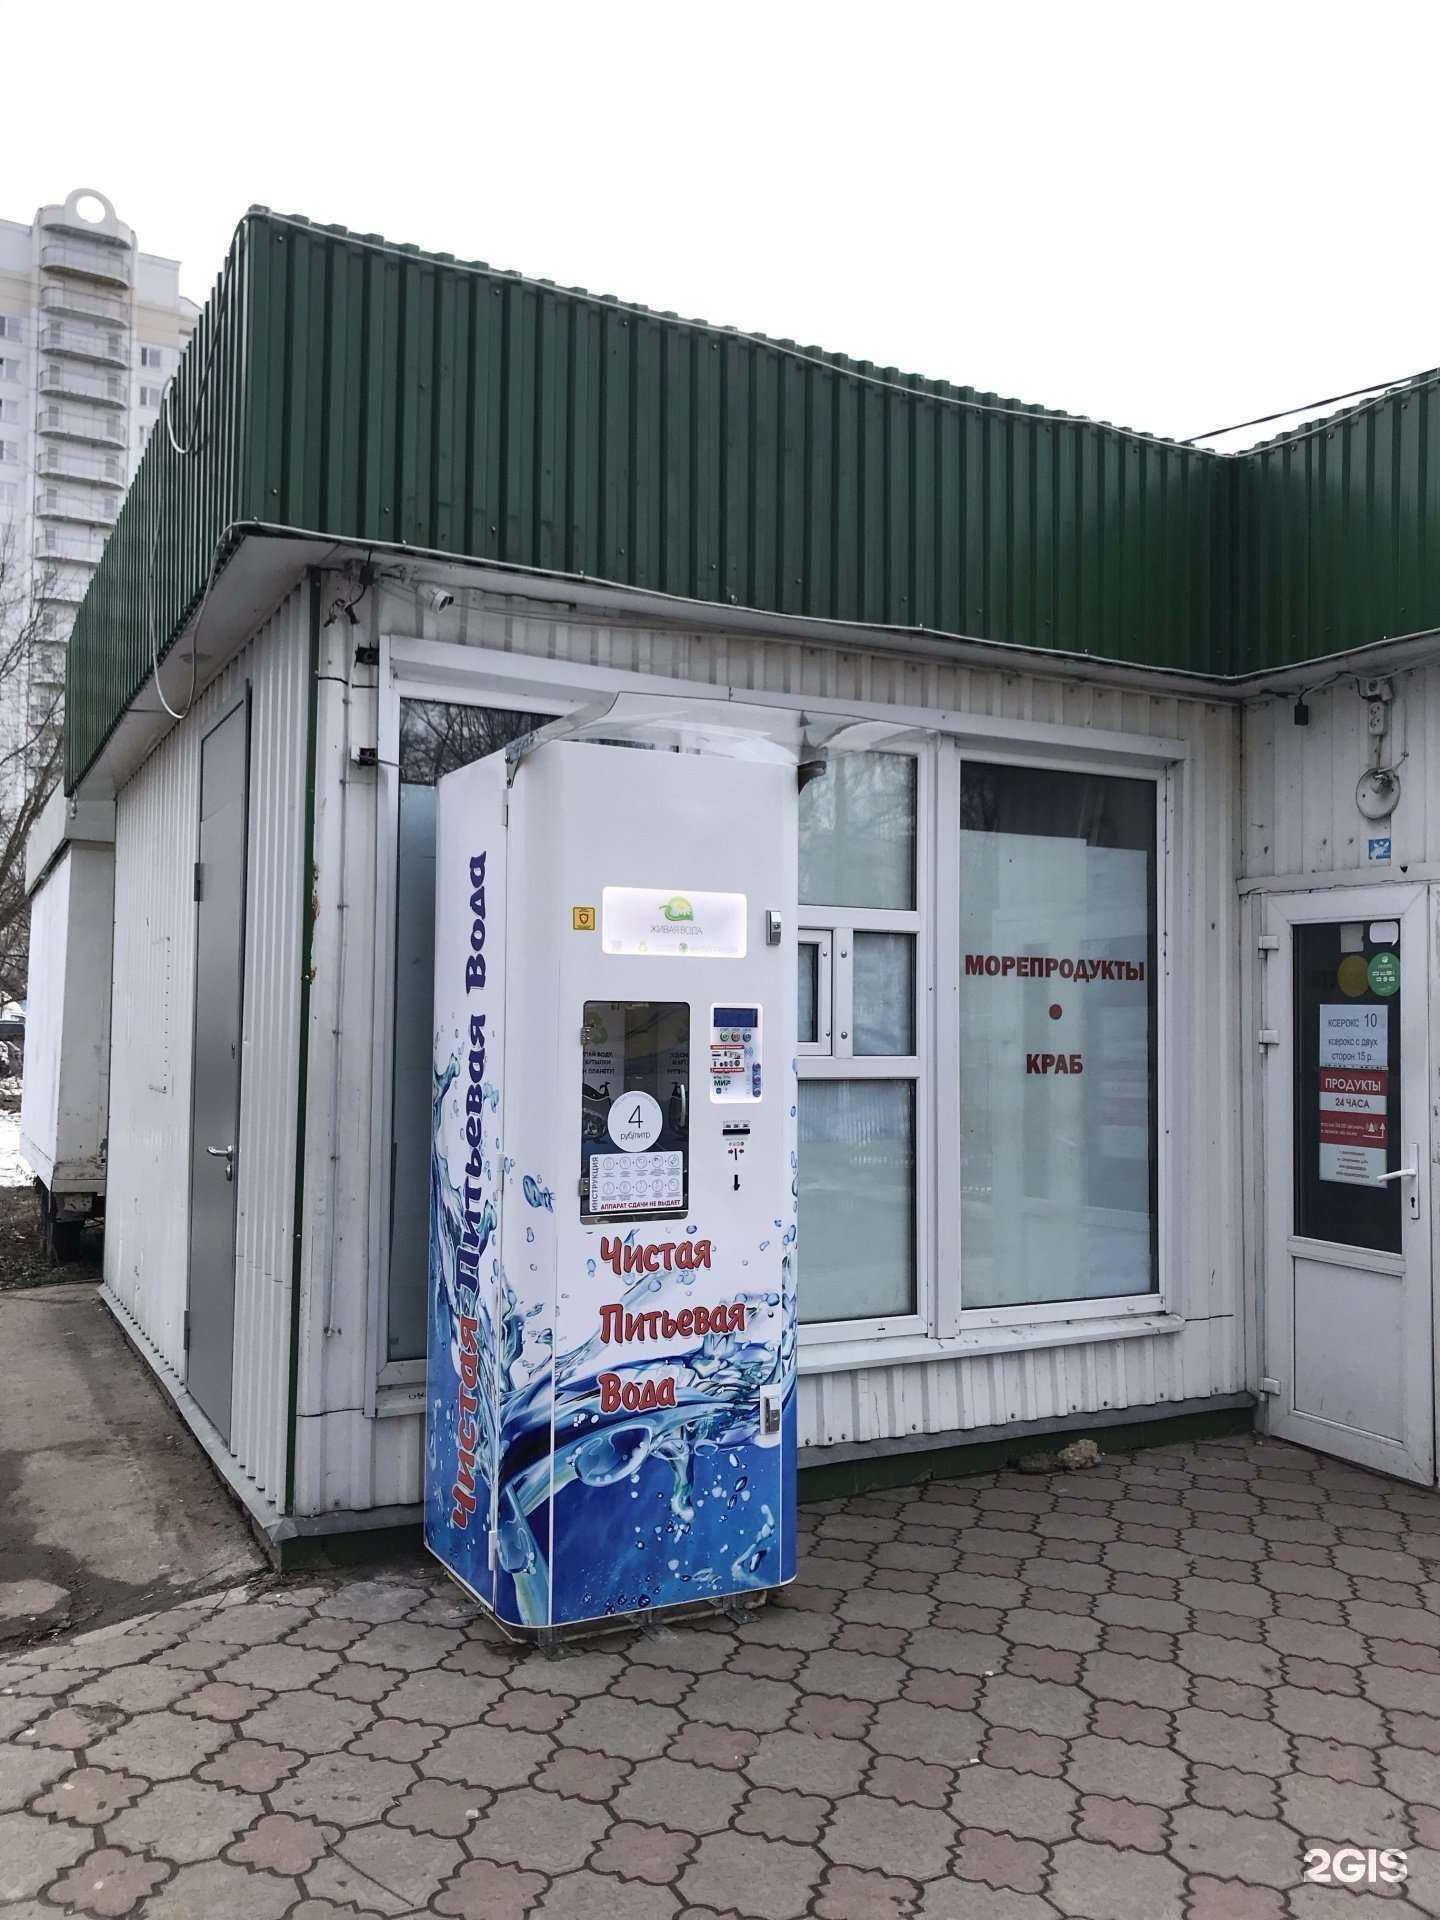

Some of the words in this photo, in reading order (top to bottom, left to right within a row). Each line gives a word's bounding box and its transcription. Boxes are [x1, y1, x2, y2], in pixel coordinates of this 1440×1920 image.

[466, 850, 487, 995] Вода
[965, 954, 1145, 982] МОРЕПРОДУКТЫ
[1327, 1018, 1360, 1029] КСЕРОКС
[1364, 1012, 1378, 1028] 10
[1328, 1036, 1355, 1050] ксерокс
[1361, 1038, 1378, 1053] двух
[1331, 1052, 1355, 1064] сторон
[1357, 1051, 1366, 1062] 15
[1026, 1054, 1084, 1074] КРАБ
[1325, 1078, 1381, 1092] ПРОДУКТЫ
[1335, 1098, 1345, 1107] 24
[1346, 1099, 1370, 1109] ЧАСА
[628, 1105, 644, 1129] 4
[456, 1014, 486, 1299] Питьевая
[591, 1156, 600, 1211] ИНСТРУКЦИЯ
[600, 1202, 627, 1210] АППАРАТ
[600, 1236, 712, 1275] Чистая
[600, 1303, 746, 1344] Питьевая
[600, 1372, 676, 1413] Вода
[452, 1314, 480, 1531] Чистая
